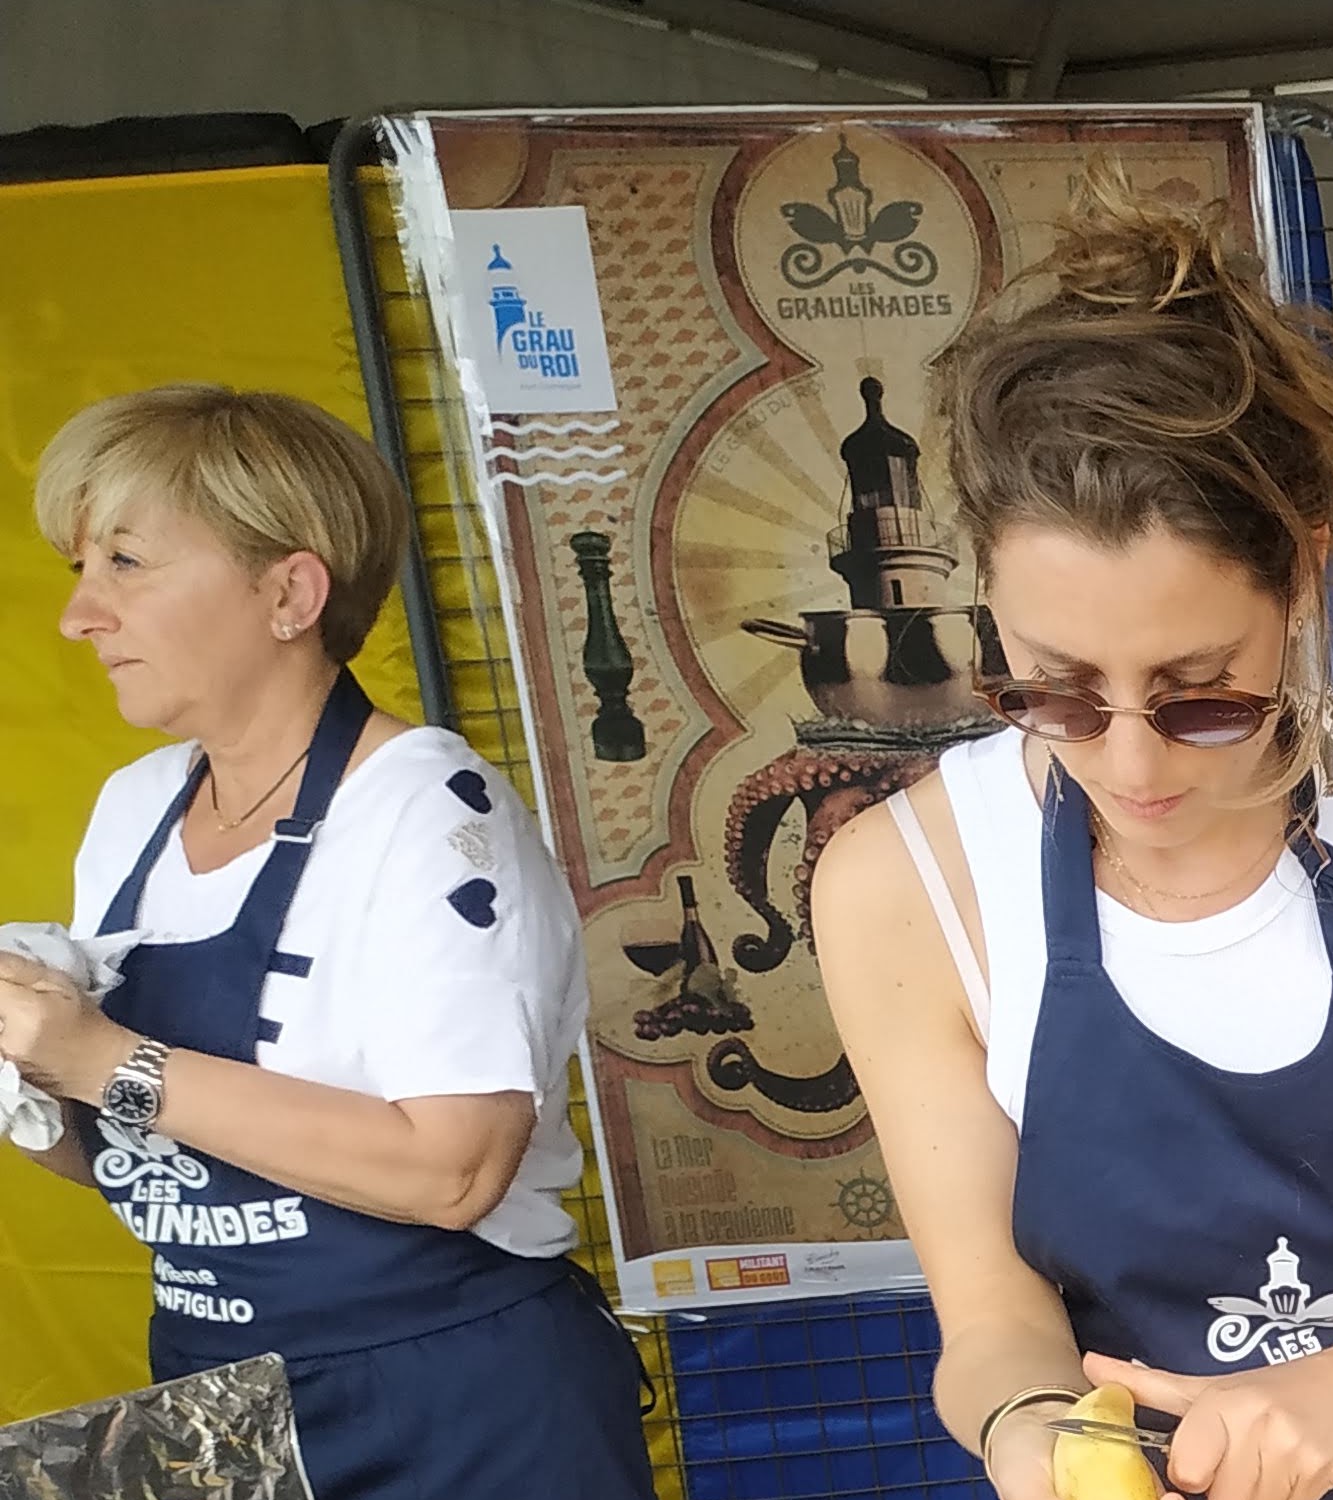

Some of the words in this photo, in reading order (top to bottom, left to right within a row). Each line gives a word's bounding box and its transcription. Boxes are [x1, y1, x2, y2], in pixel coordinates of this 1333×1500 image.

[849, 283, 875, 295] LES
[528, 311, 546, 328] LE
[777, 295, 952, 320] GRAULINADES
[512, 328, 575, 353] GRAU
[518, 354, 538, 369] DU
[540, 353, 580, 377] ROI
[130, 1180, 181, 1203] LES
[111, 1196, 308, 1246] LINADES
[154, 1281, 254, 1325] NFIGLIO
[1259, 1327, 1322, 1366] LES
